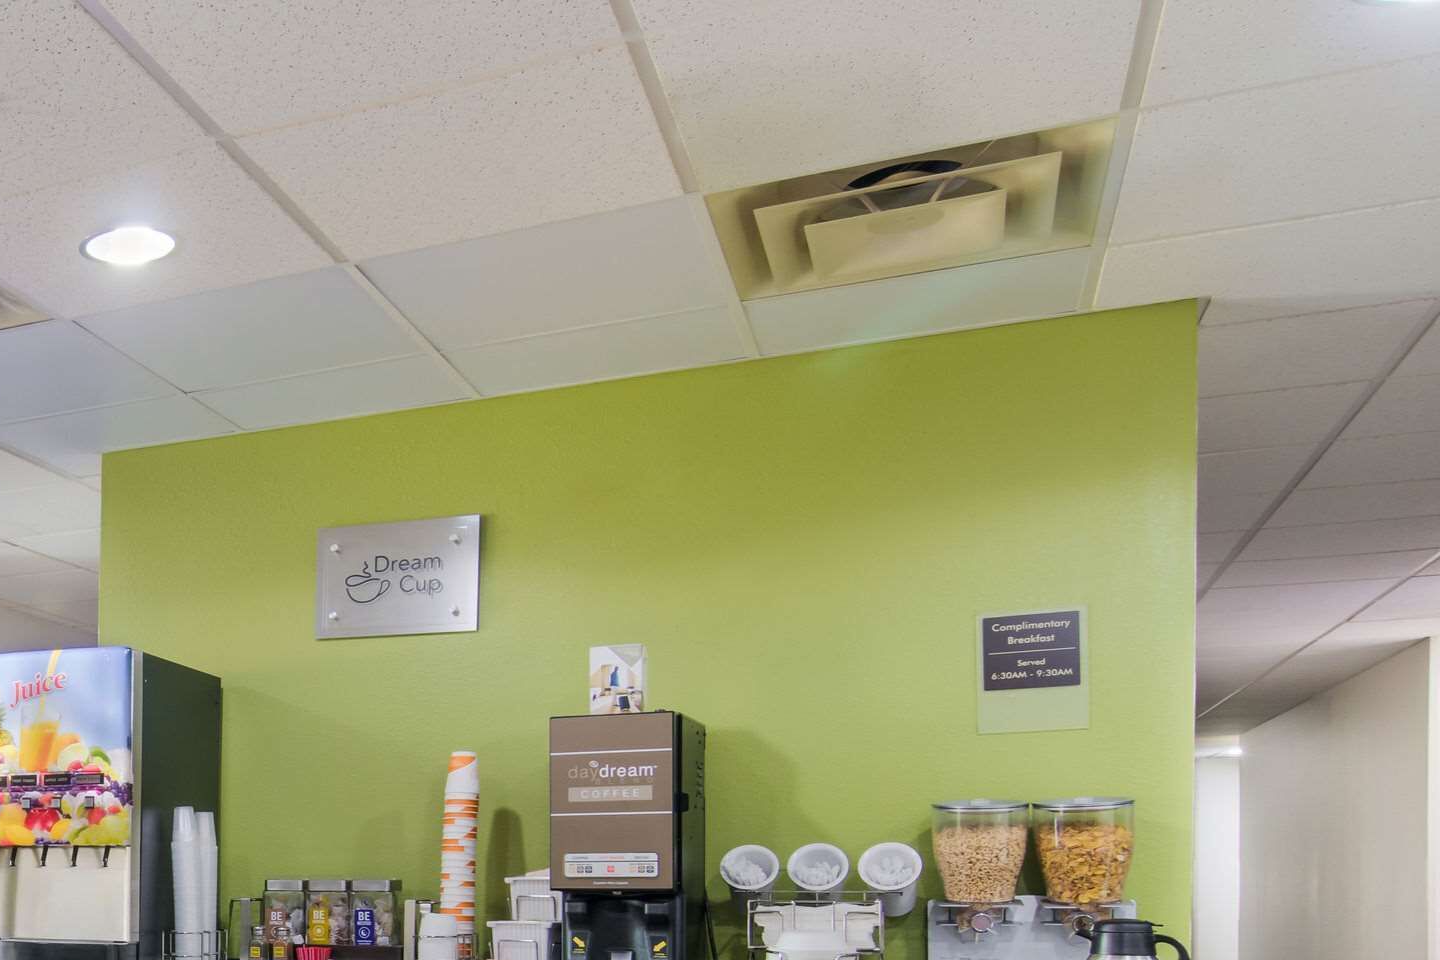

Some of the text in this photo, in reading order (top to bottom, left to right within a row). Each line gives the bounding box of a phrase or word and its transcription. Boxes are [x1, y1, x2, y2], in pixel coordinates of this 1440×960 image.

[374, 555, 442, 573] Dream
[399, 575, 443, 597] Cup
[991, 620, 1071, 632] Complimentary
[1007, 634, 1055, 645] Breakfast
[1016, 658, 1046, 667] Served
[8, 671, 67, 709] Juice
[580, 788, 641, 799] COFFEE
[271, 911, 283, 921] BE
[313, 910, 325, 920] BE
[358, 911, 370, 921] BE
